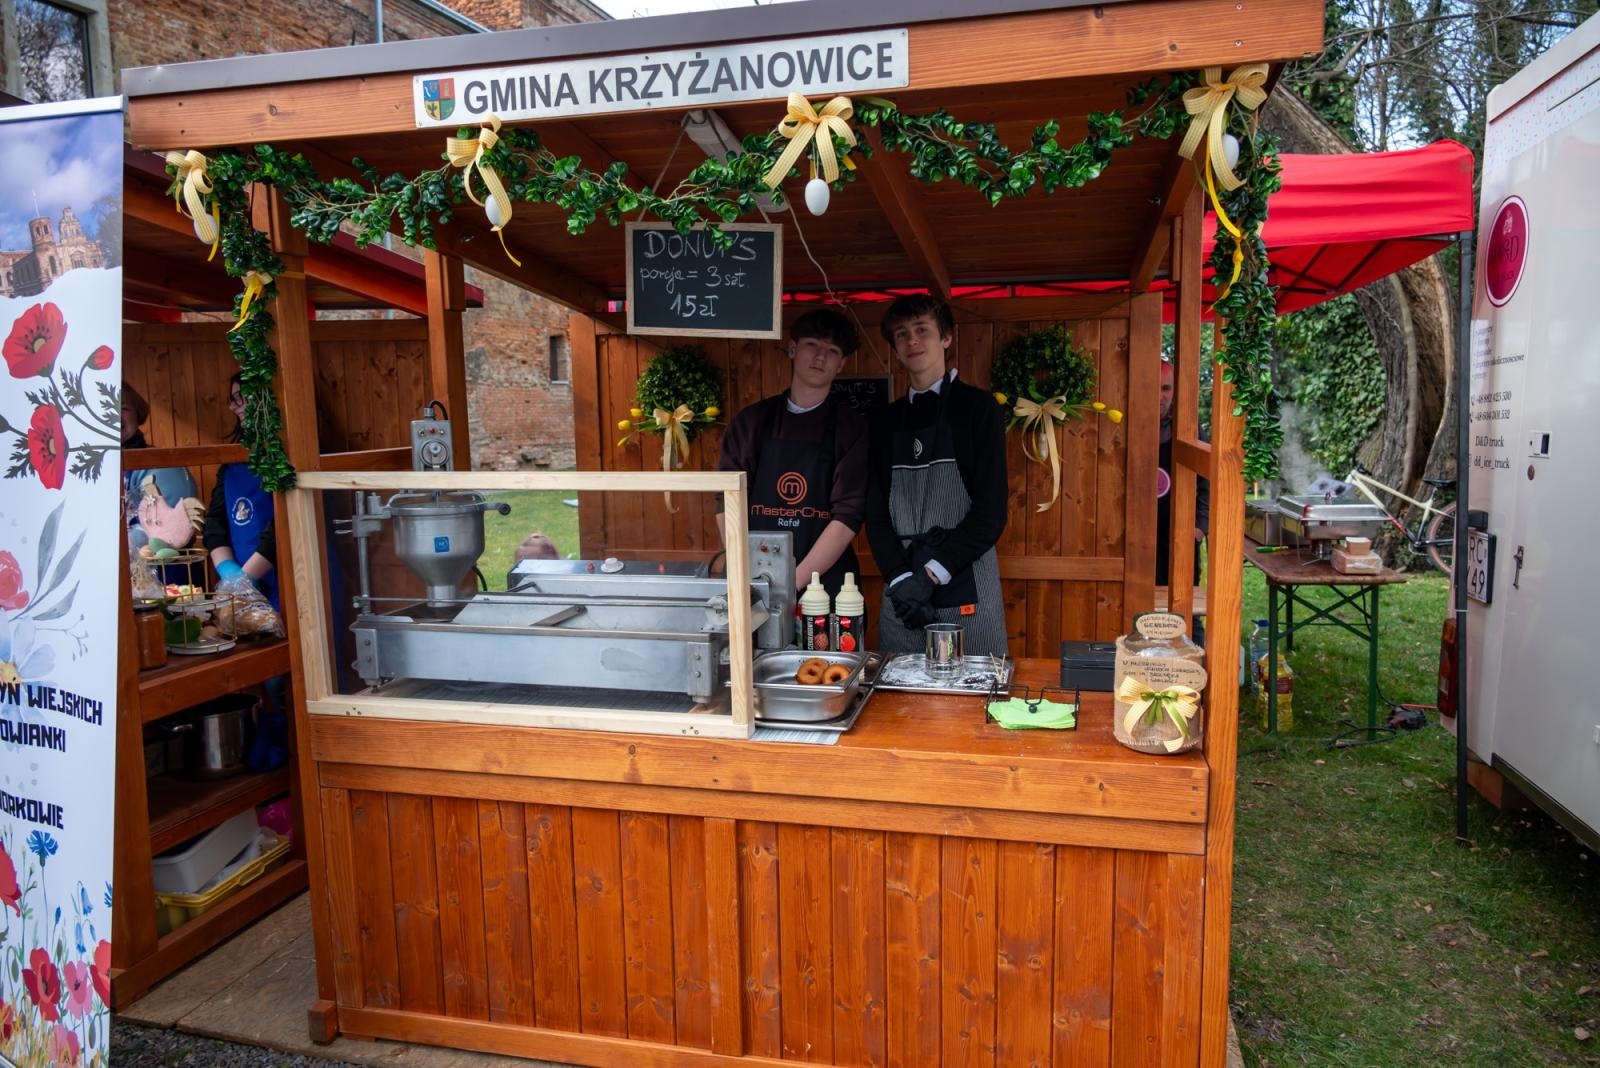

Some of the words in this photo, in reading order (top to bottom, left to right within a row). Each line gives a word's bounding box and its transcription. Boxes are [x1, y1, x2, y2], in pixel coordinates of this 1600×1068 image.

[464, 72, 580, 115] GMINA
[588, 42, 893, 104] KRZYŻANOWICE
[1489, 435, 1504, 448] truck
[751, 503, 832, 519] MasterChe
[1469, 536, 1484, 565] RC
[1467, 565, 1486, 595] 49
[27, 684, 103, 726] WIEJSKICH
[0, 718, 66, 753] OWIANKI
[0, 789, 64, 830] ORKOWIE
